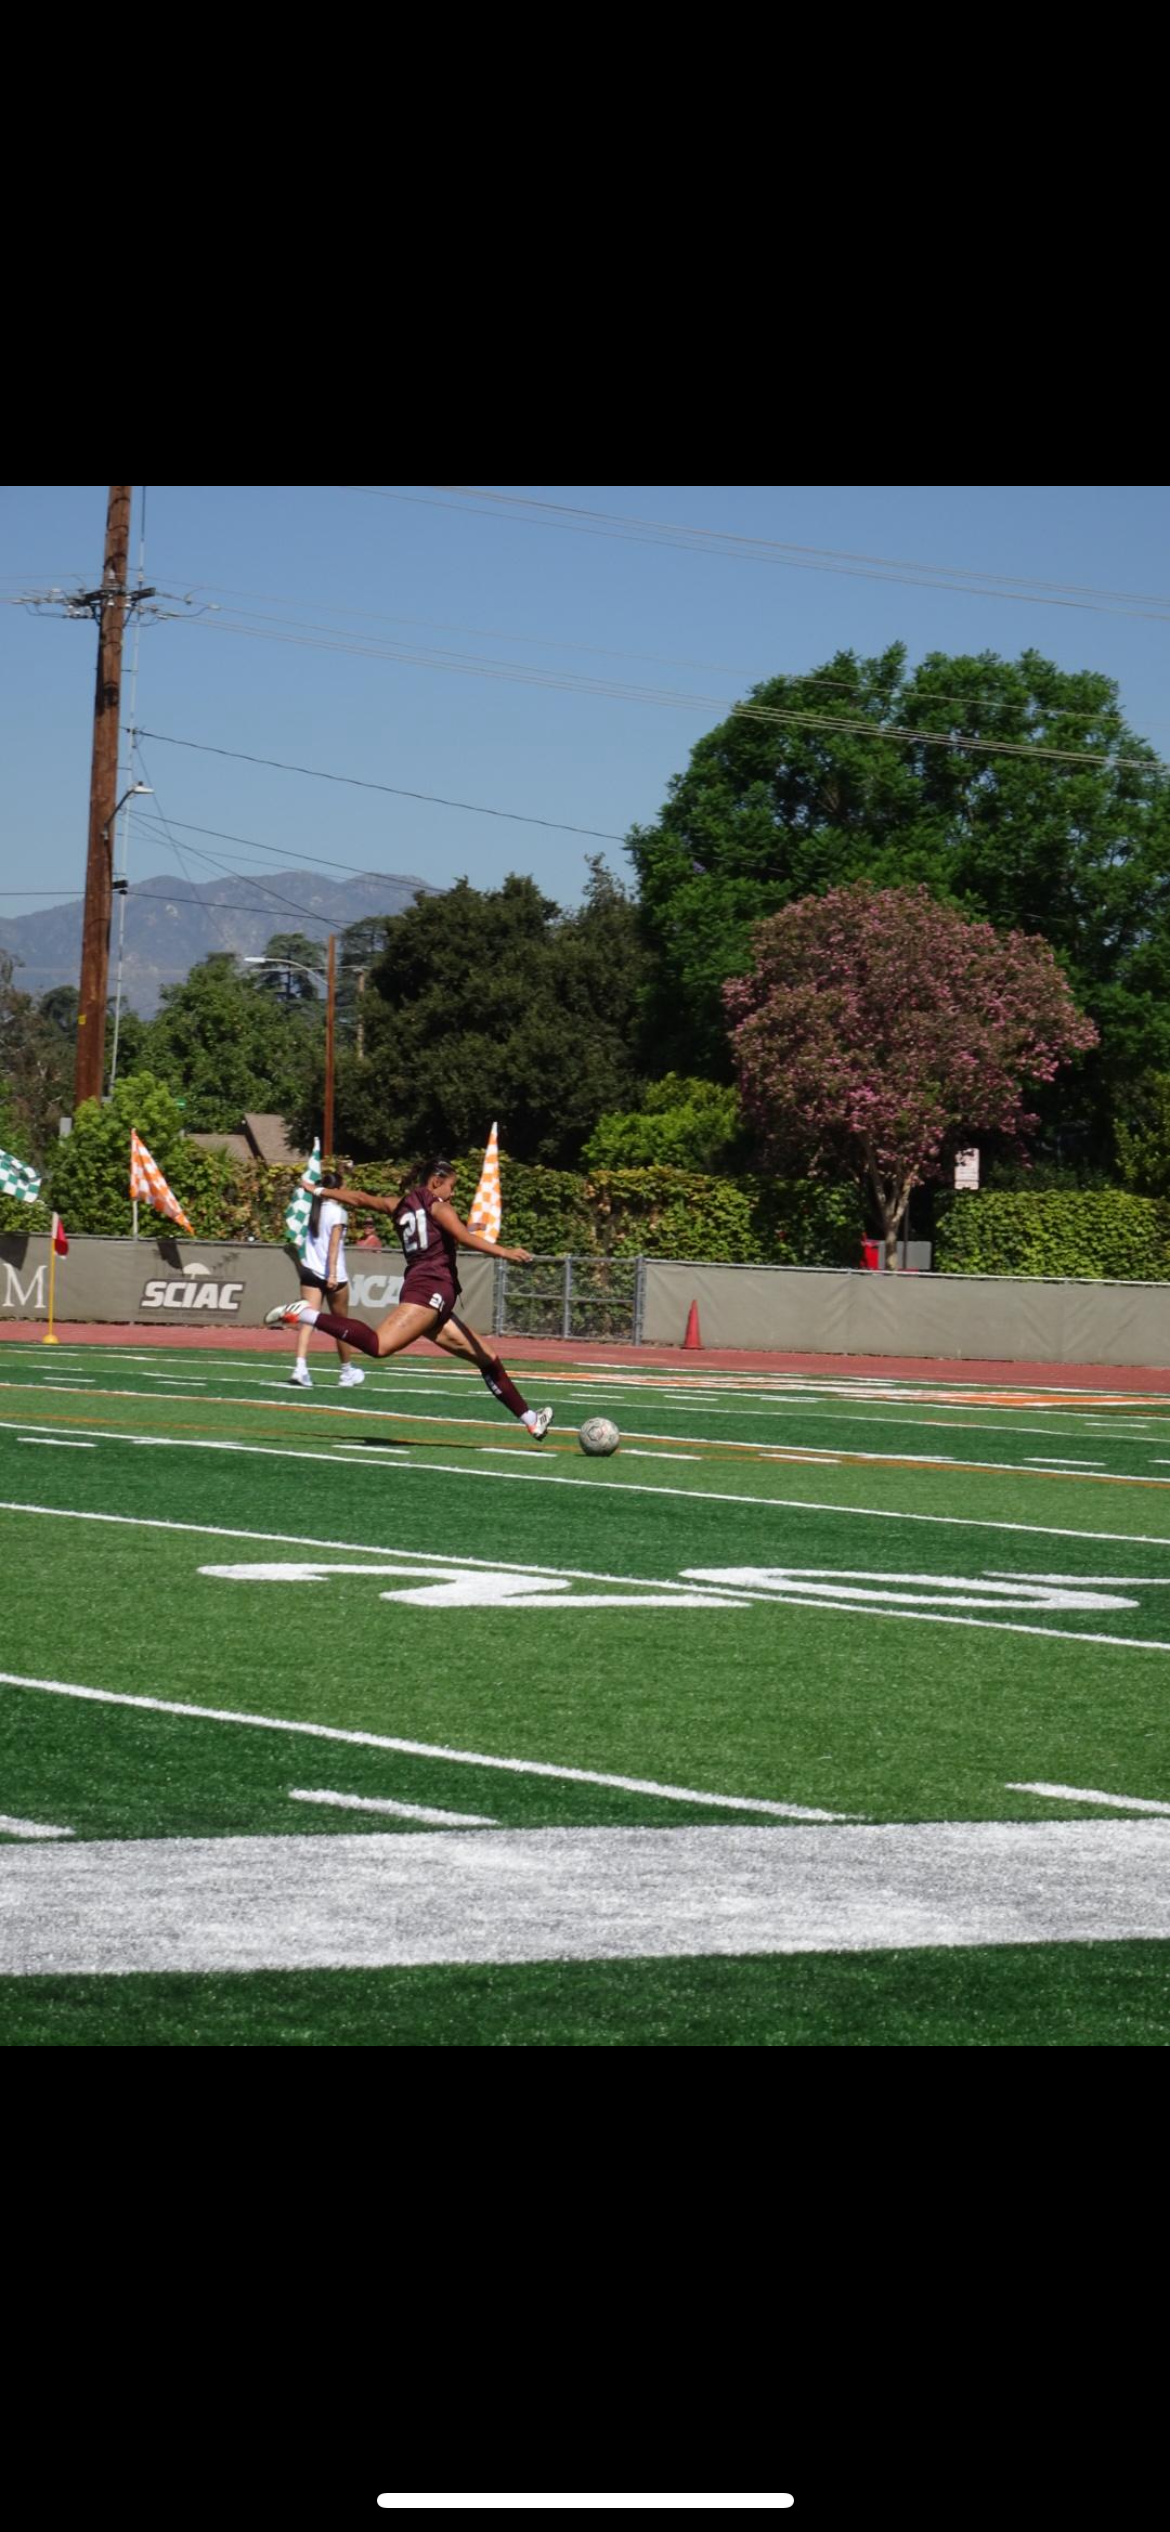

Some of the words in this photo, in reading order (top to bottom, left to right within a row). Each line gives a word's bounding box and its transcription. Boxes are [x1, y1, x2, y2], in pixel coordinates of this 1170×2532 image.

[399, 1208, 428, 1252] 21
[2, 1262, 48, 1309] M
[141, 1281, 243, 1311] SCIAC
